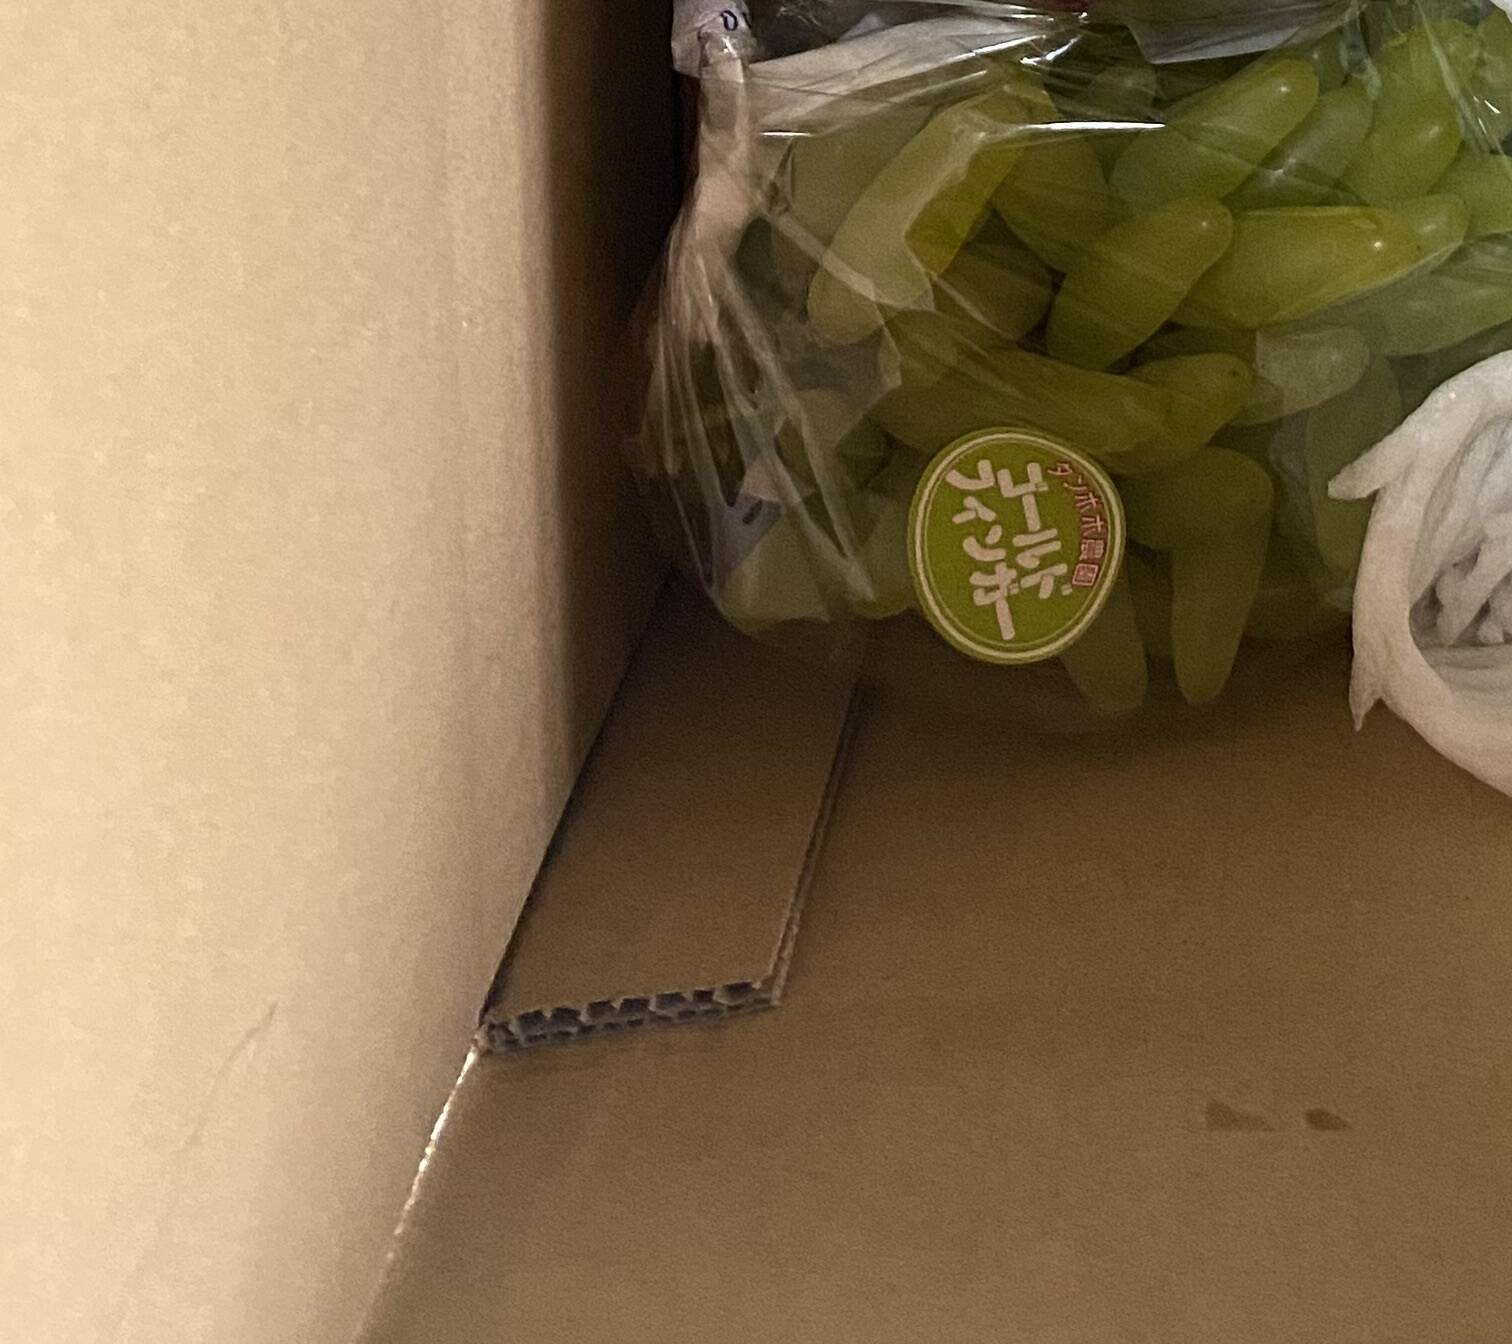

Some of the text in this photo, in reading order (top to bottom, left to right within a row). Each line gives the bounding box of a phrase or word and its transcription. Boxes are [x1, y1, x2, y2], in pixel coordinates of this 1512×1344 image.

[944, 459, 1020, 640] フィンガー
[995, 462, 1073, 600] ゴールド
